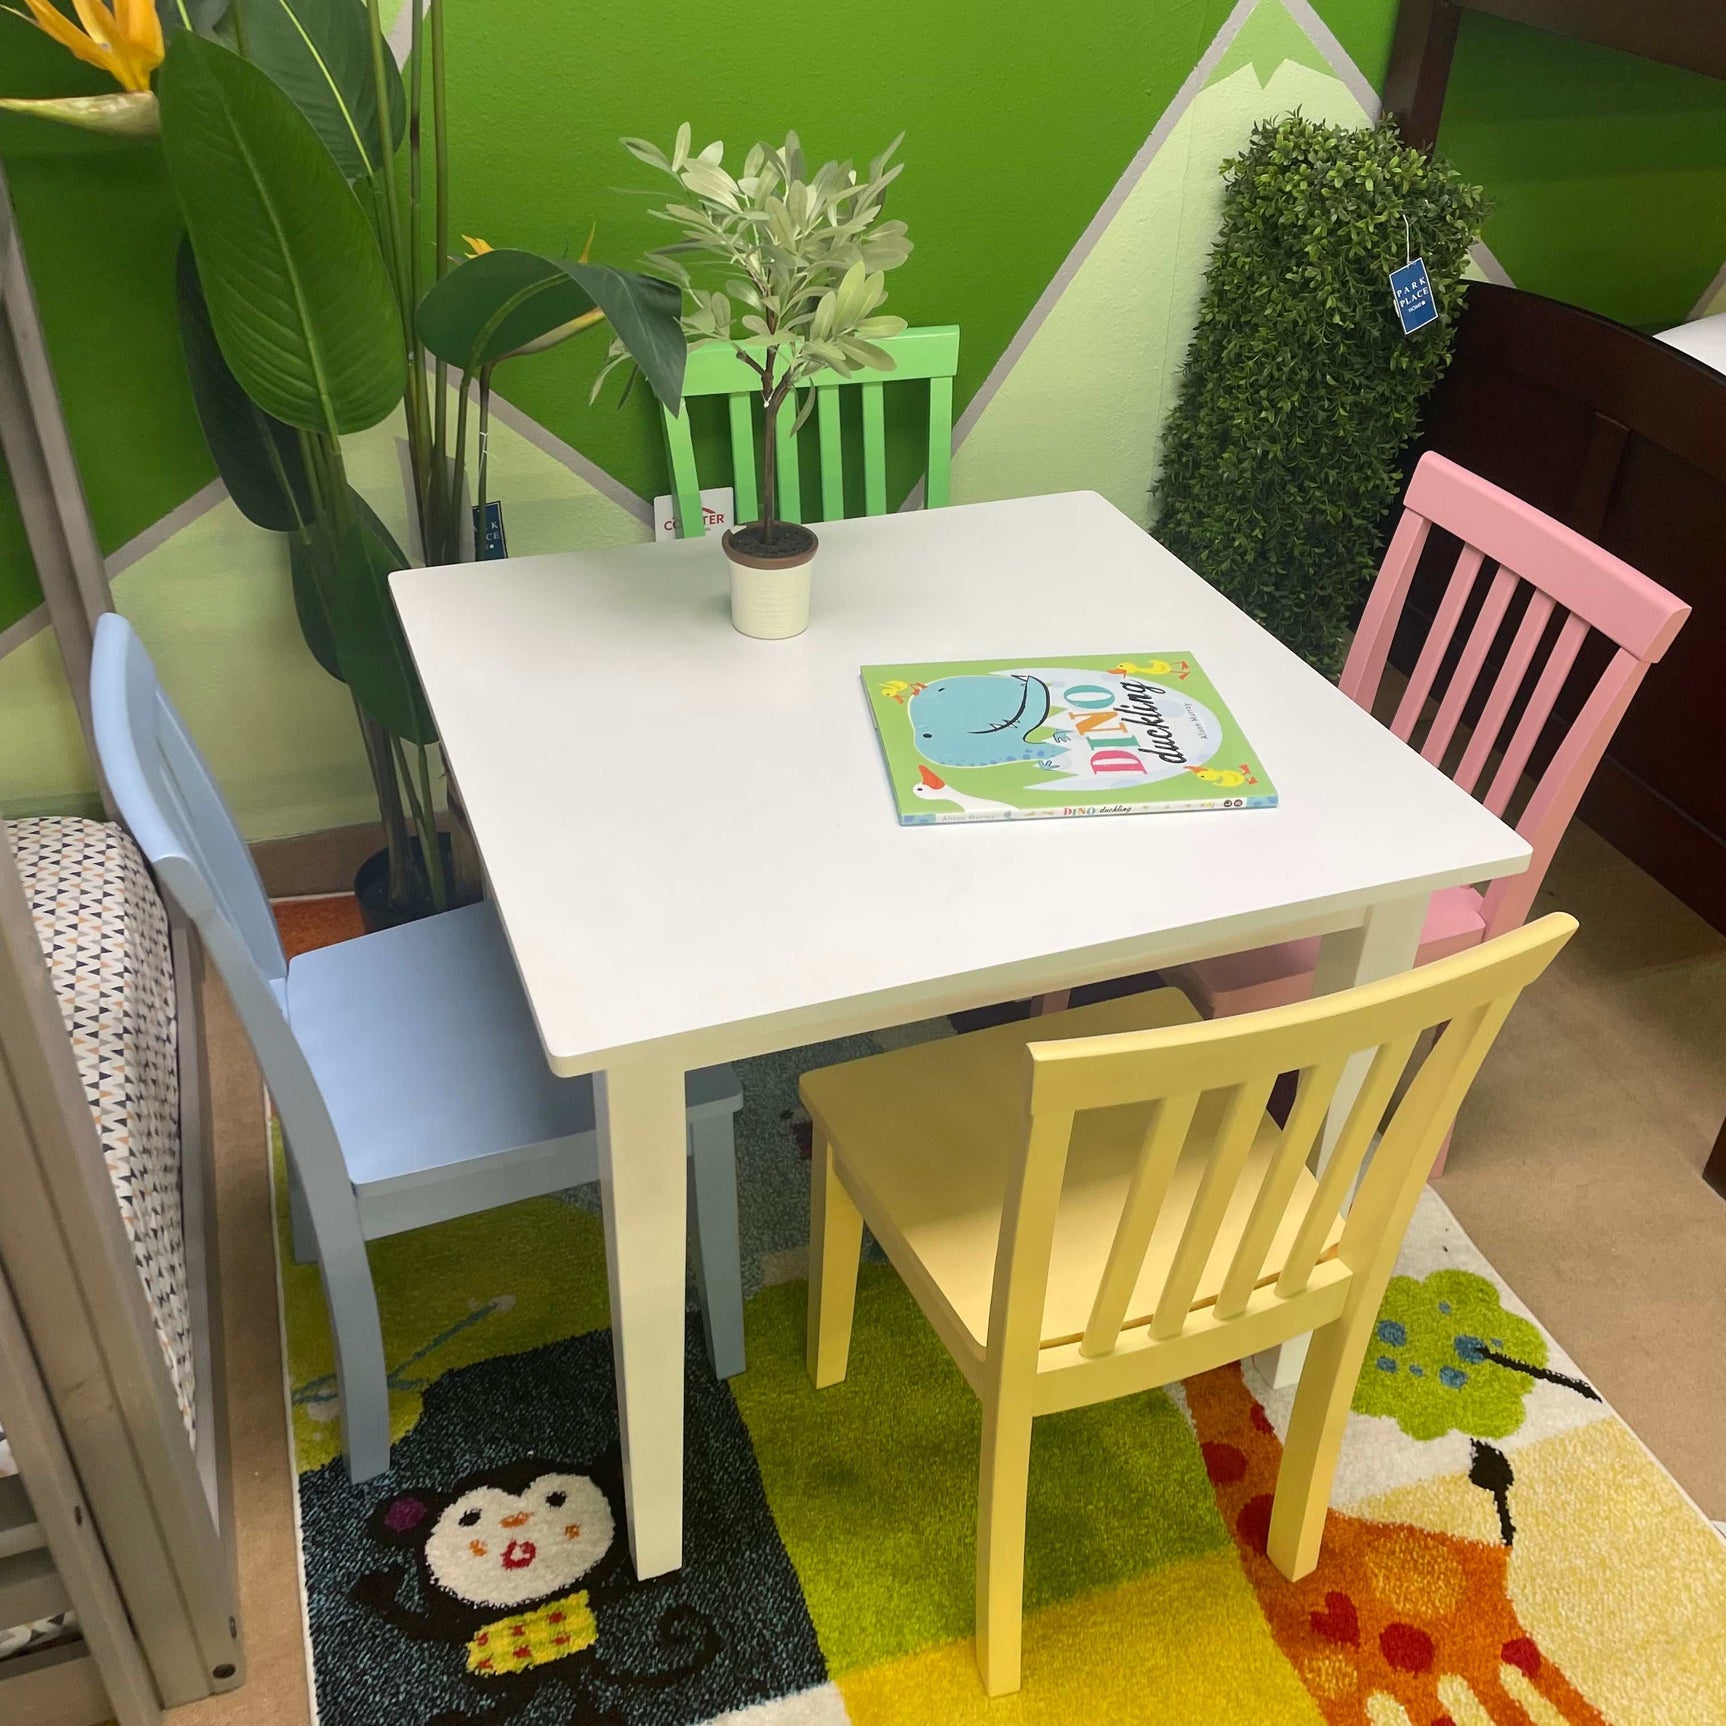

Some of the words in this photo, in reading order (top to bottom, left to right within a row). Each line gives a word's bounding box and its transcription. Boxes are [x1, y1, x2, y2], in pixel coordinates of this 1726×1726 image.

[1396, 276, 1426, 298] PARK
[1399, 286, 1429, 308] PLACE
[1063, 684, 1148, 775] DINO
[1112, 679, 1188, 764] duckling
[1063, 806, 1096, 816] DINO
[1099, 804, 1132, 813] duckling
